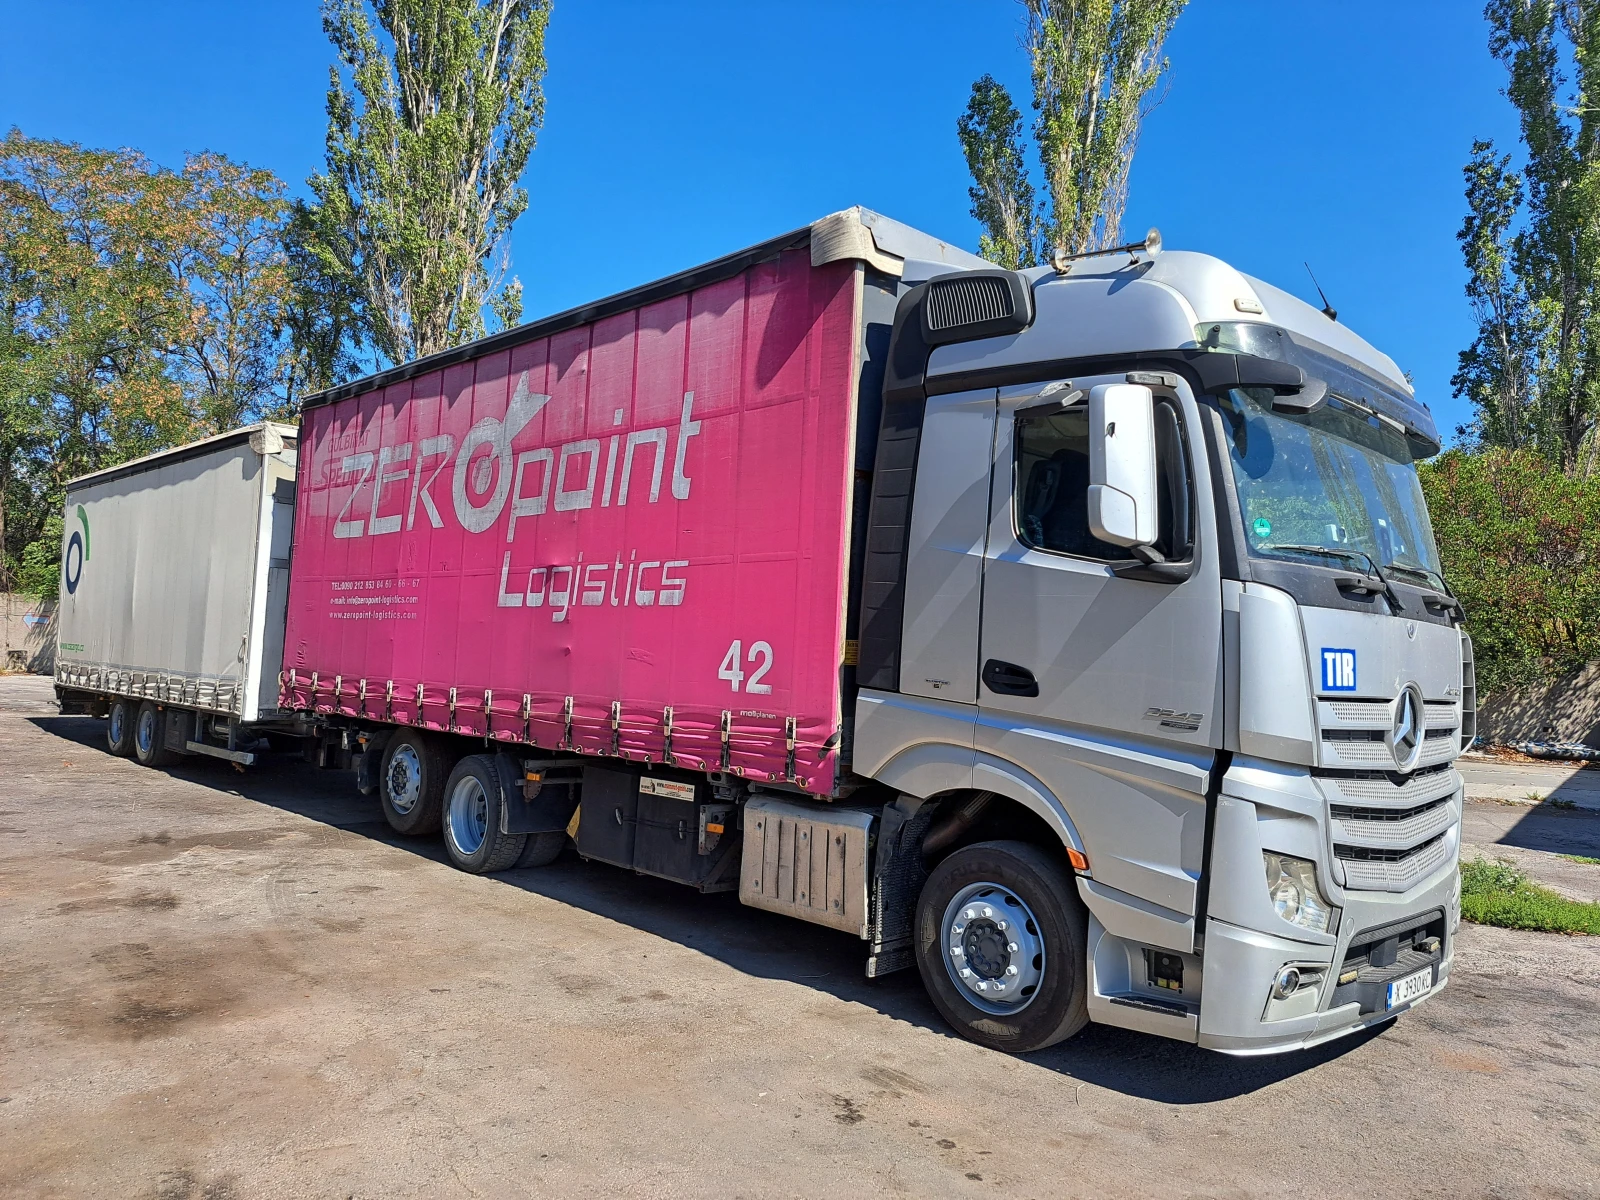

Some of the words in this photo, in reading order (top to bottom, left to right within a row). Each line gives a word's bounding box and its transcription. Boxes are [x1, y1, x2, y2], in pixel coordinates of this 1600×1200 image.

[497, 549, 690, 623] Logistics
[718, 639, 774, 695] 42
[1324, 652, 1355, 687] TIR
